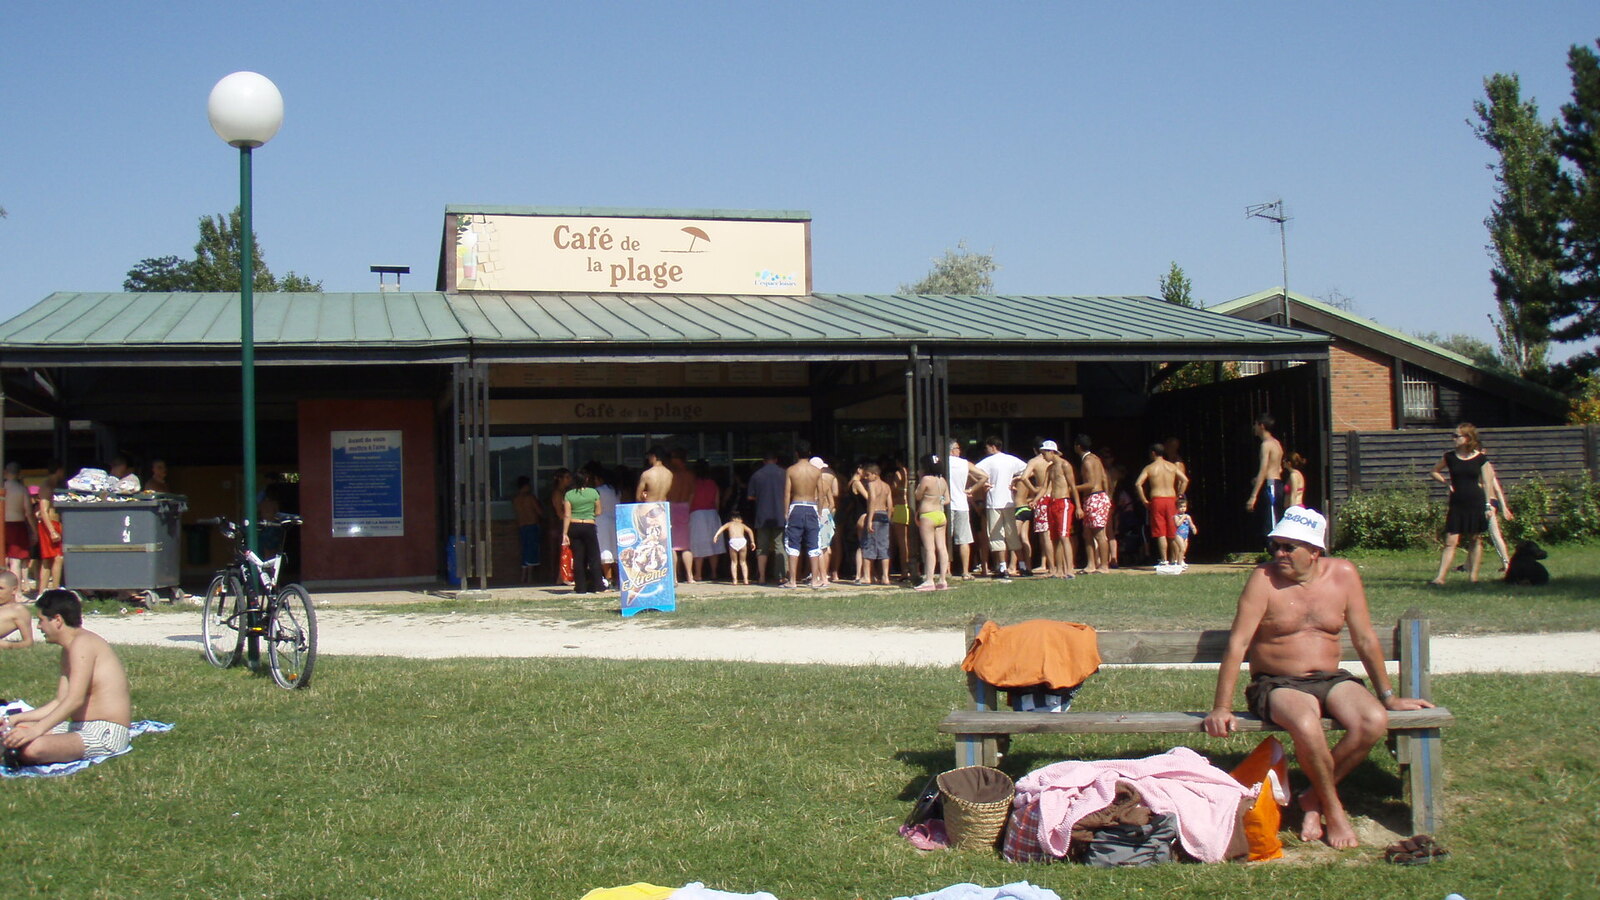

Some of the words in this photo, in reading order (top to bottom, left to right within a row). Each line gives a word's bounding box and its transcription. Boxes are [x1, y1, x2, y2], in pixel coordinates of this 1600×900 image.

[553, 224, 613, 250] Café
[620, 236, 640, 251] de
[587, 257, 603, 272] la
[609, 257, 683, 289] plage
[574, 403, 614, 418] Café
[619, 408, 633, 417] de
[638, 408, 649, 417] la
[654, 402, 702, 420] plage
[973, 398, 1017, 416] plage
